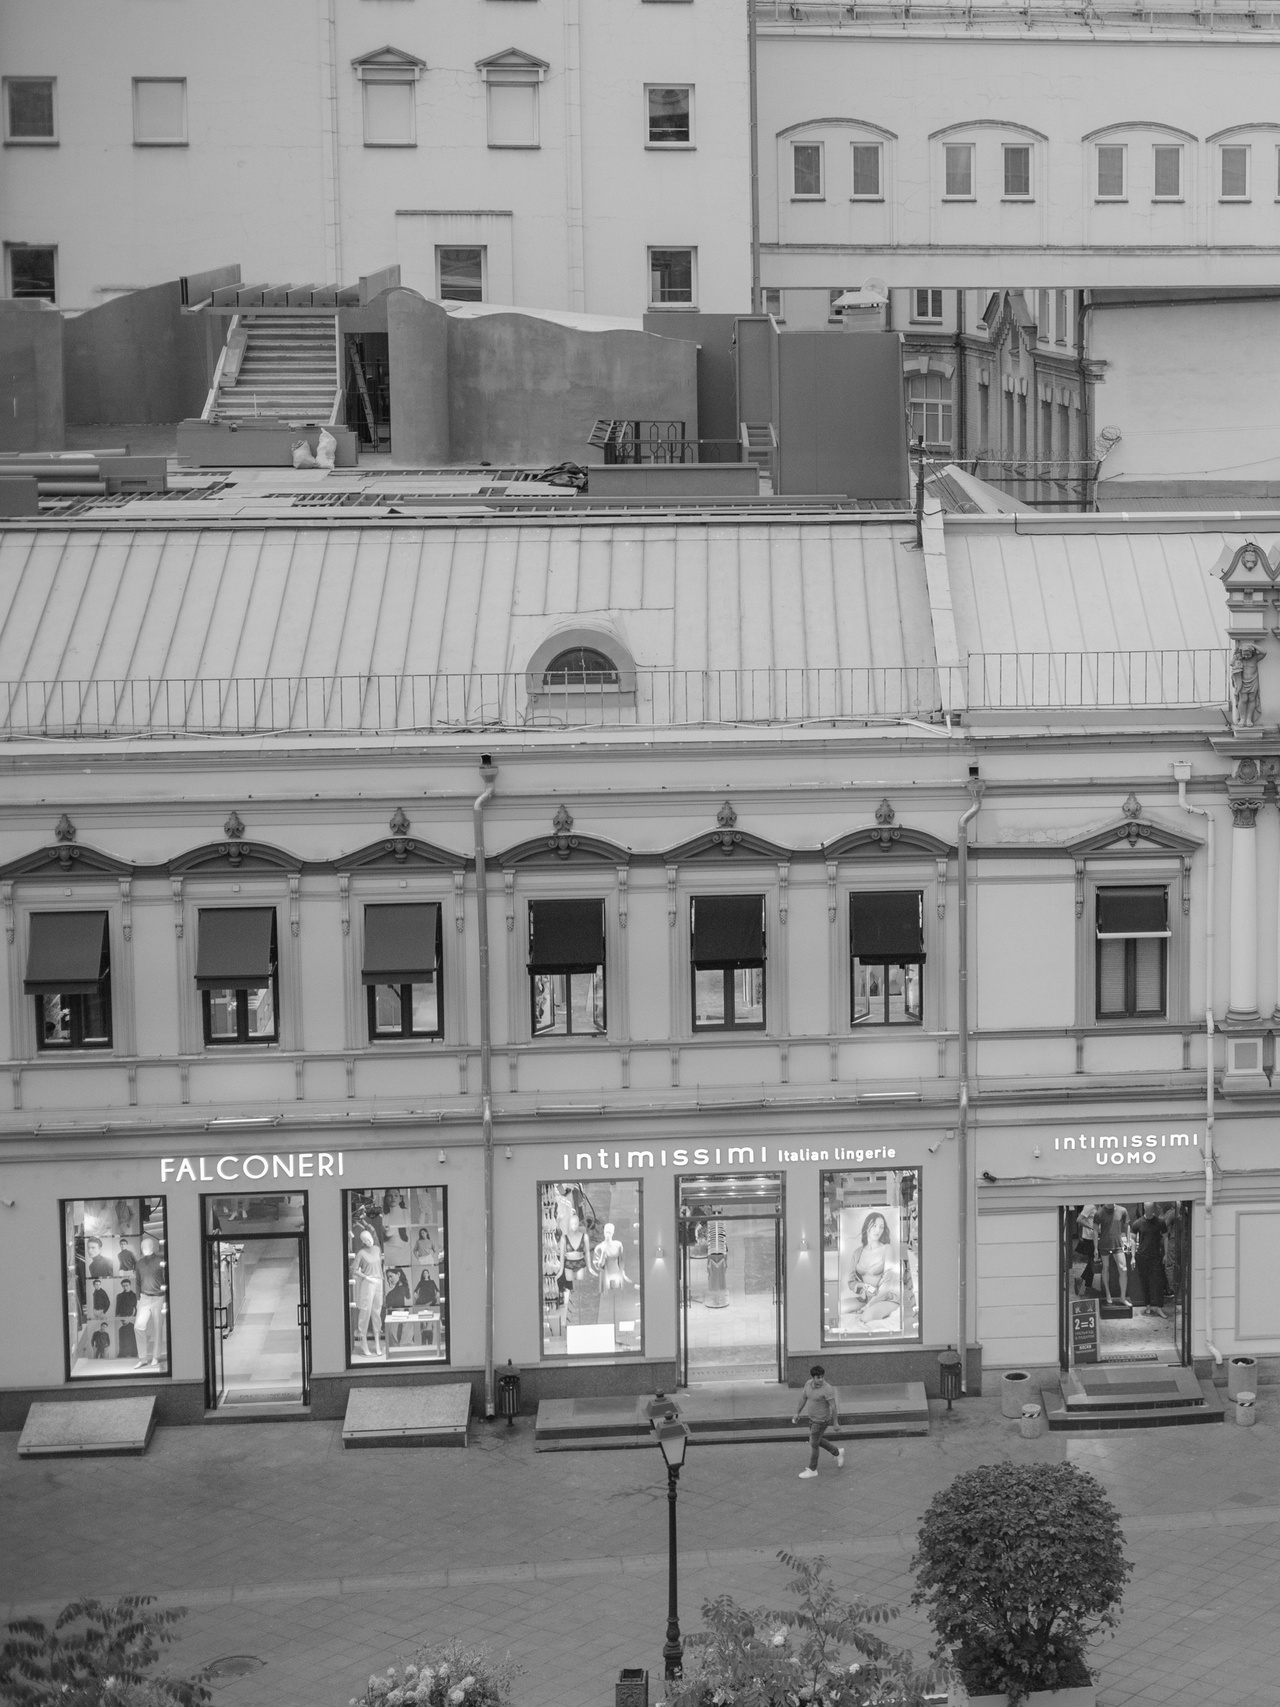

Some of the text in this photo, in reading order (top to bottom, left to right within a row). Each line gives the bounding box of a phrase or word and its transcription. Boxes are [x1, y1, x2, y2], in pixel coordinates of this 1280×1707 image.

[1054, 1133, 1198, 1150] intimissimi
[563, 1146, 896, 1170] intimissimi Italian lingerie
[1096, 1151, 1157, 1166] UOMO
[160, 1152, 344, 1183] FALCONERI
[1074, 1317, 1095, 1330] 2=3
